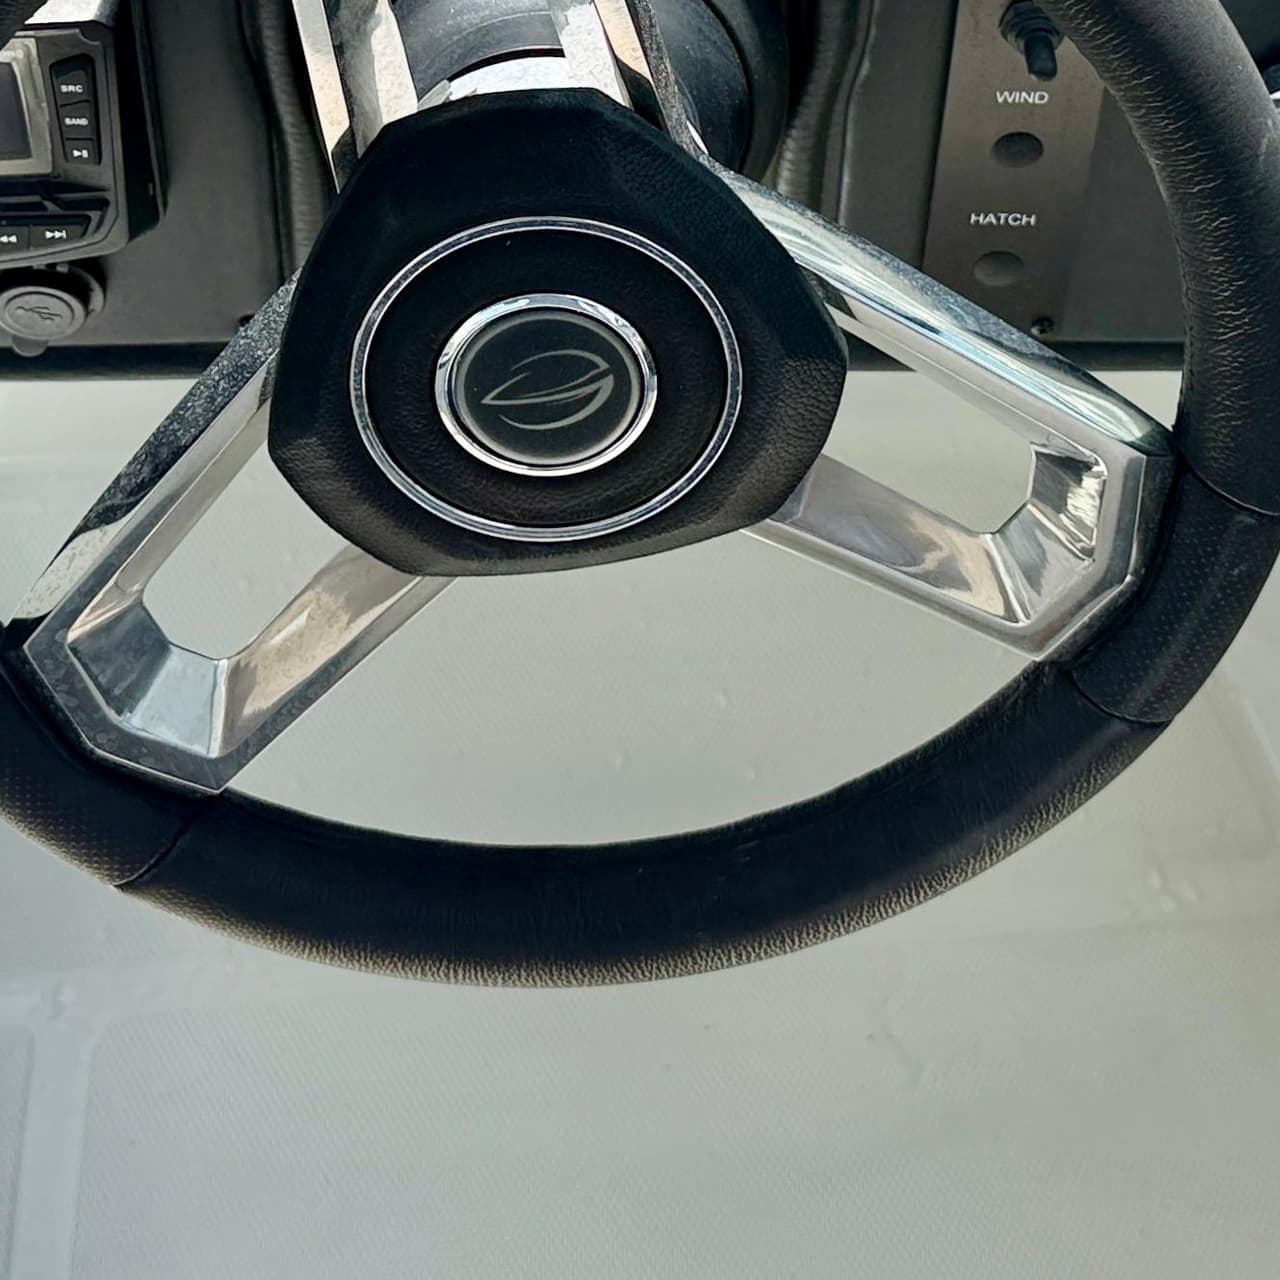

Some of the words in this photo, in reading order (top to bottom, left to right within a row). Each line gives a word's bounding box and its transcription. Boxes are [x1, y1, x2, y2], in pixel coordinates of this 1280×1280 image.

[60, 84, 83, 93] SRC
[995, 90, 1049, 105] WIND
[970, 211, 1036, 227] HATCH
